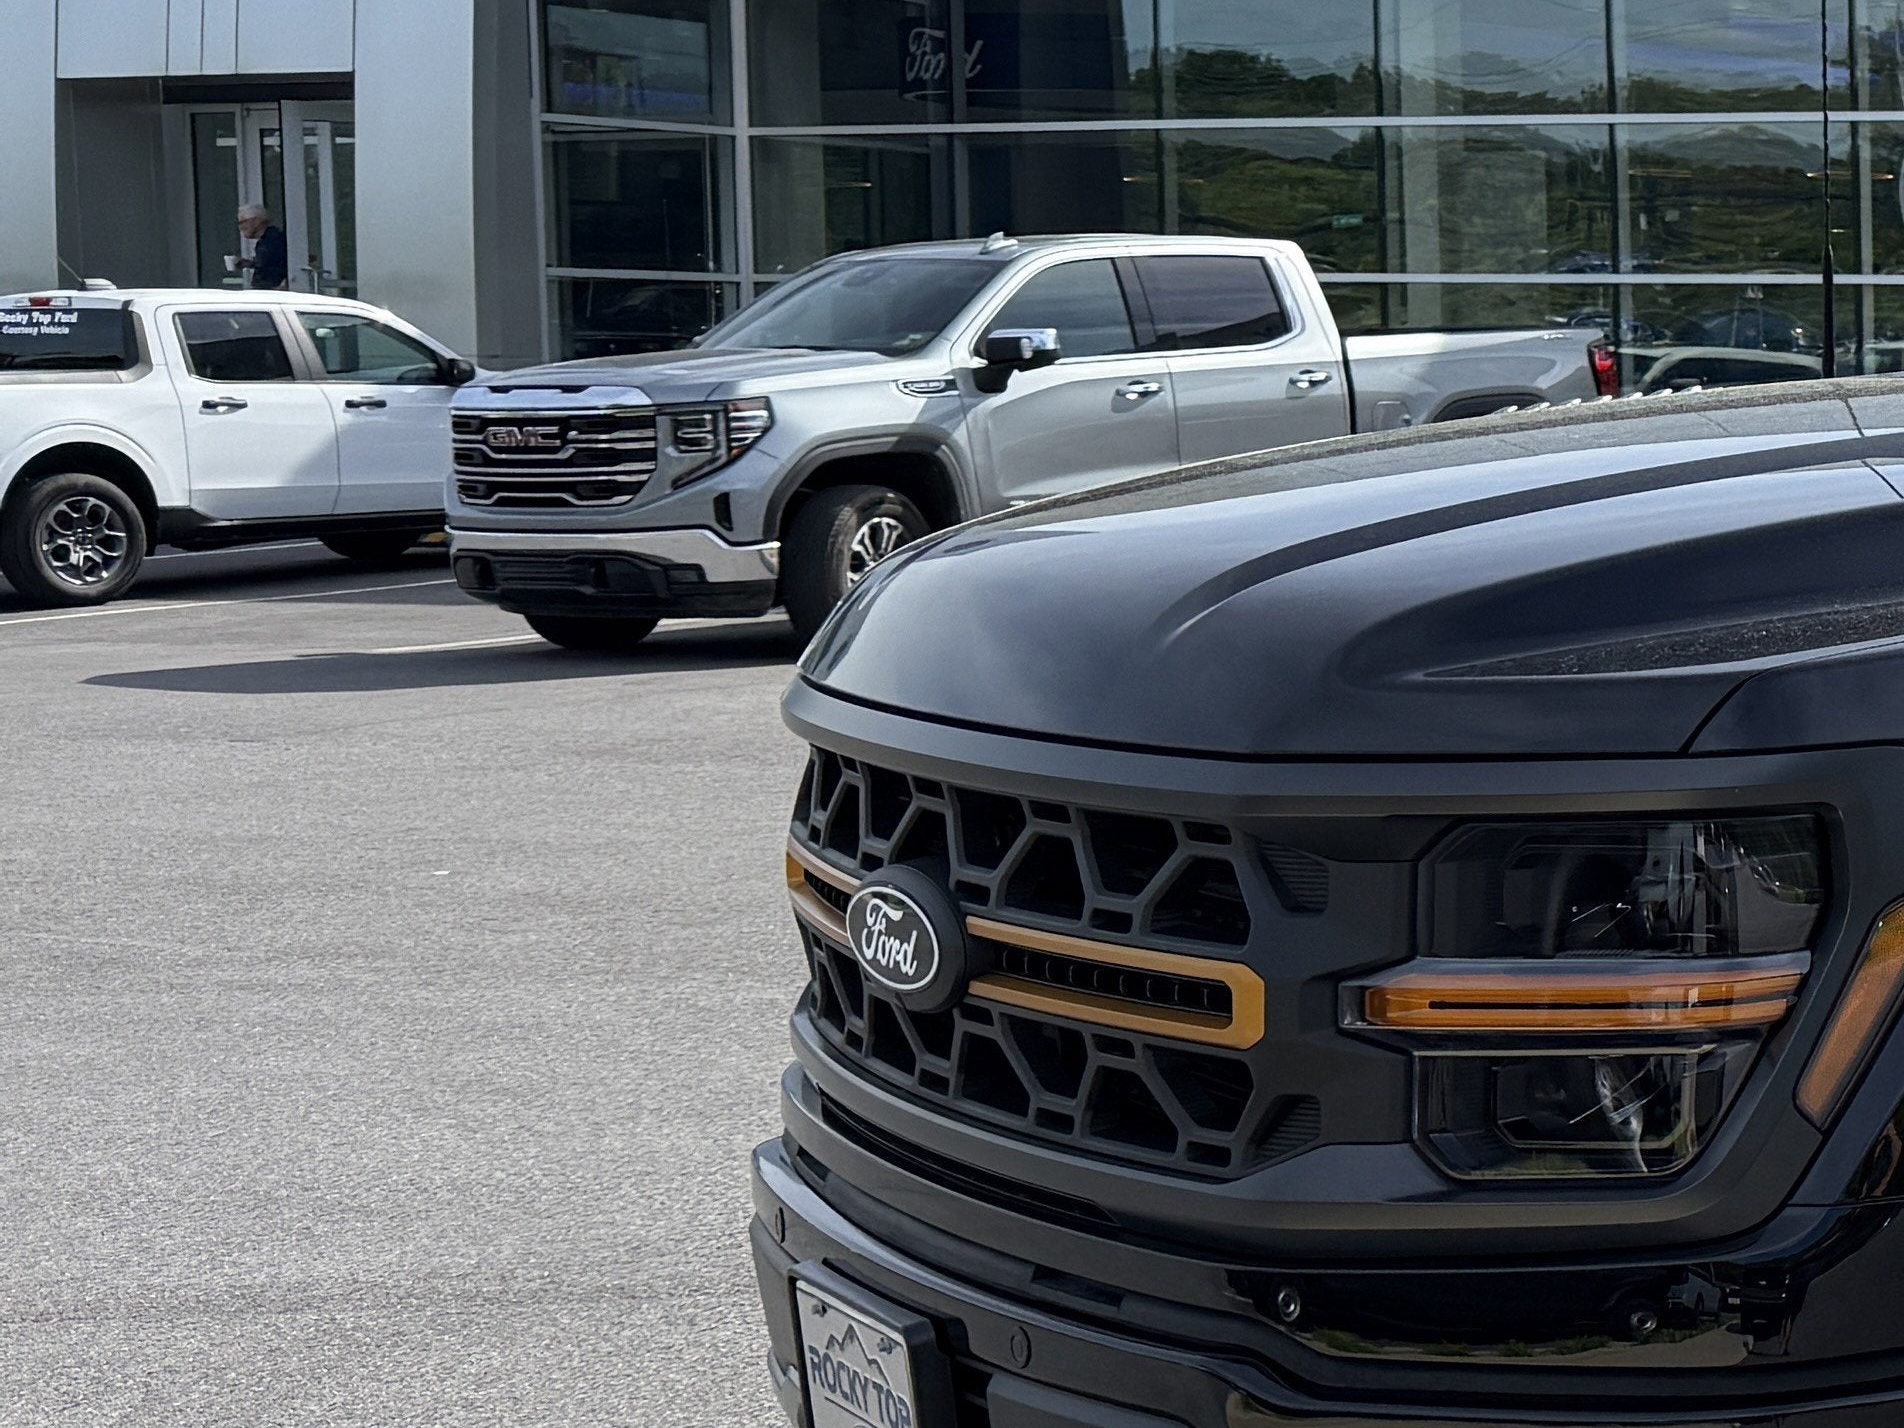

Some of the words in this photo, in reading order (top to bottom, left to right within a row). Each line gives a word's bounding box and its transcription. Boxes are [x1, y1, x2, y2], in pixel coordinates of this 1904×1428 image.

[484, 426, 561, 446] GMC
[861, 898, 918, 977] Ford
[808, 1344, 871, 1414] ROCKY
